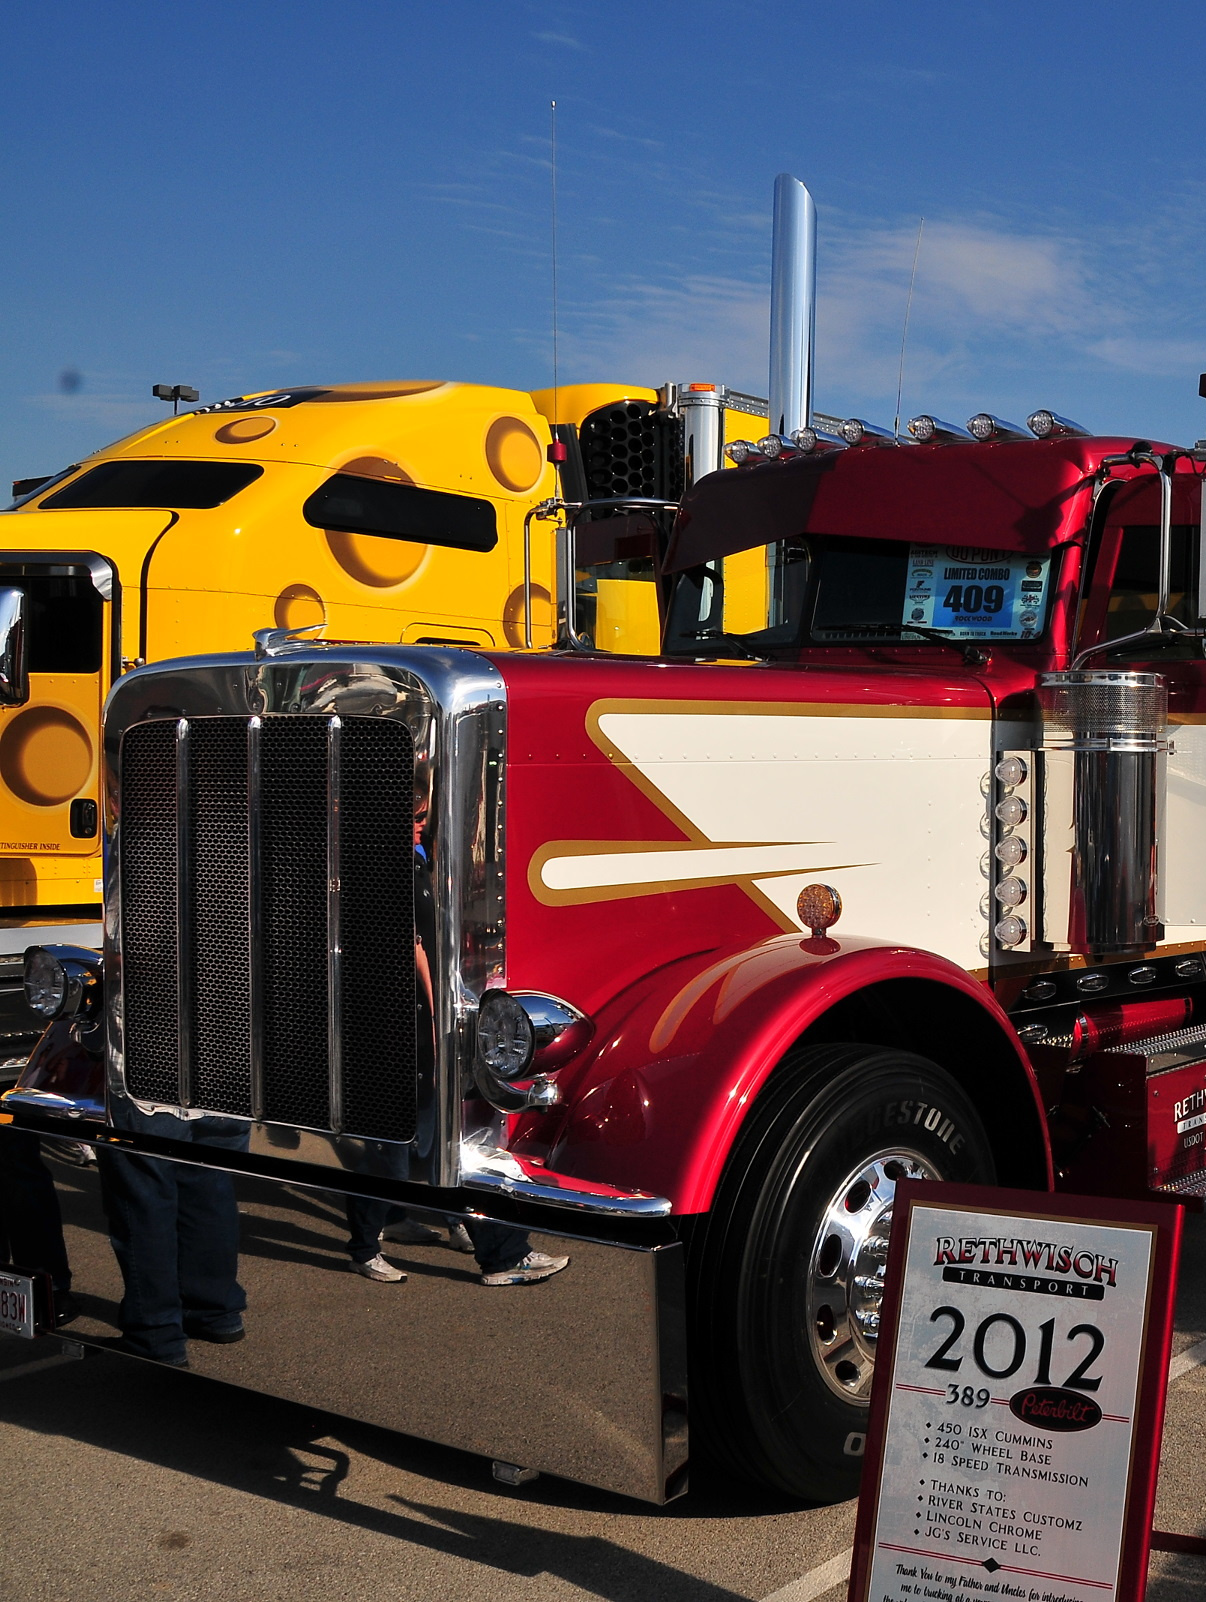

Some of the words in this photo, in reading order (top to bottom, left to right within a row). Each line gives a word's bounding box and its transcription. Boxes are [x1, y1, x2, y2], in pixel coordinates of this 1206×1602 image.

[944, 567, 977, 580] LIMITED
[978, 567, 1010, 580] COMBO
[943, 585, 1004, 614] 409
[0, 842, 38, 850] TINGUISHER
[40, 843, 61, 851] INSIDE
[1184, 1131, 1204, 1148] USDOT
[933, 1236, 1118, 1287] RETHWISCH
[959, 1270, 1089, 1296] TRANSPORT
[924, 1305, 1105, 1392] 2012
[946, 1383, 991, 1409] 389
[1021, 1393, 1094, 1422] Peterbilt
[937, 1422, 962, 1436] 450
[968, 1426, 988, 1440] ISX
[996, 1430, 1053, 1450] CUMMINS
[972, 1442, 1013, 1460] WHEEL
[1020, 1450, 1052, 1466] BASE
[933, 1452, 944, 1464] 18
[952, 1456, 989, 1471] SPEED
[996, 1462, 1089, 1487] TRANSMISSION
[930, 1480, 980, 1498] THANKS
[987, 1490, 1006, 1502] TO:
[926, 1510, 982, 1530] LINCOLN
[990, 1522, 1042, 1540] CHROME
[928, 1494, 964, 1511] RIVER
[970, 1502, 1016, 1520] STATES
[1024, 1512, 1082, 1531] CUSTOMZ
[924, 1526, 950, 1540] JG'S
[956, 1532, 1008, 1551] SERVICE
[1014, 1542, 1041, 1556] LLC.
[896, 1564, 918, 1578] Thank
[920, 1567, 934, 1580] You
[935, 1570, 942, 1582] to
[944, 1576, 957, 1589] my
[958, 1576, 984, 1590] Father
[984, 1582, 1000, 1594] and
[1001, 1584, 1026, 1598] Uncles
[1028, 1588, 1040, 1602] for
[900, 1584, 912, 1593] me
[914, 1584, 922, 1595] to
[924, 1586, 953, 1602] trucking
